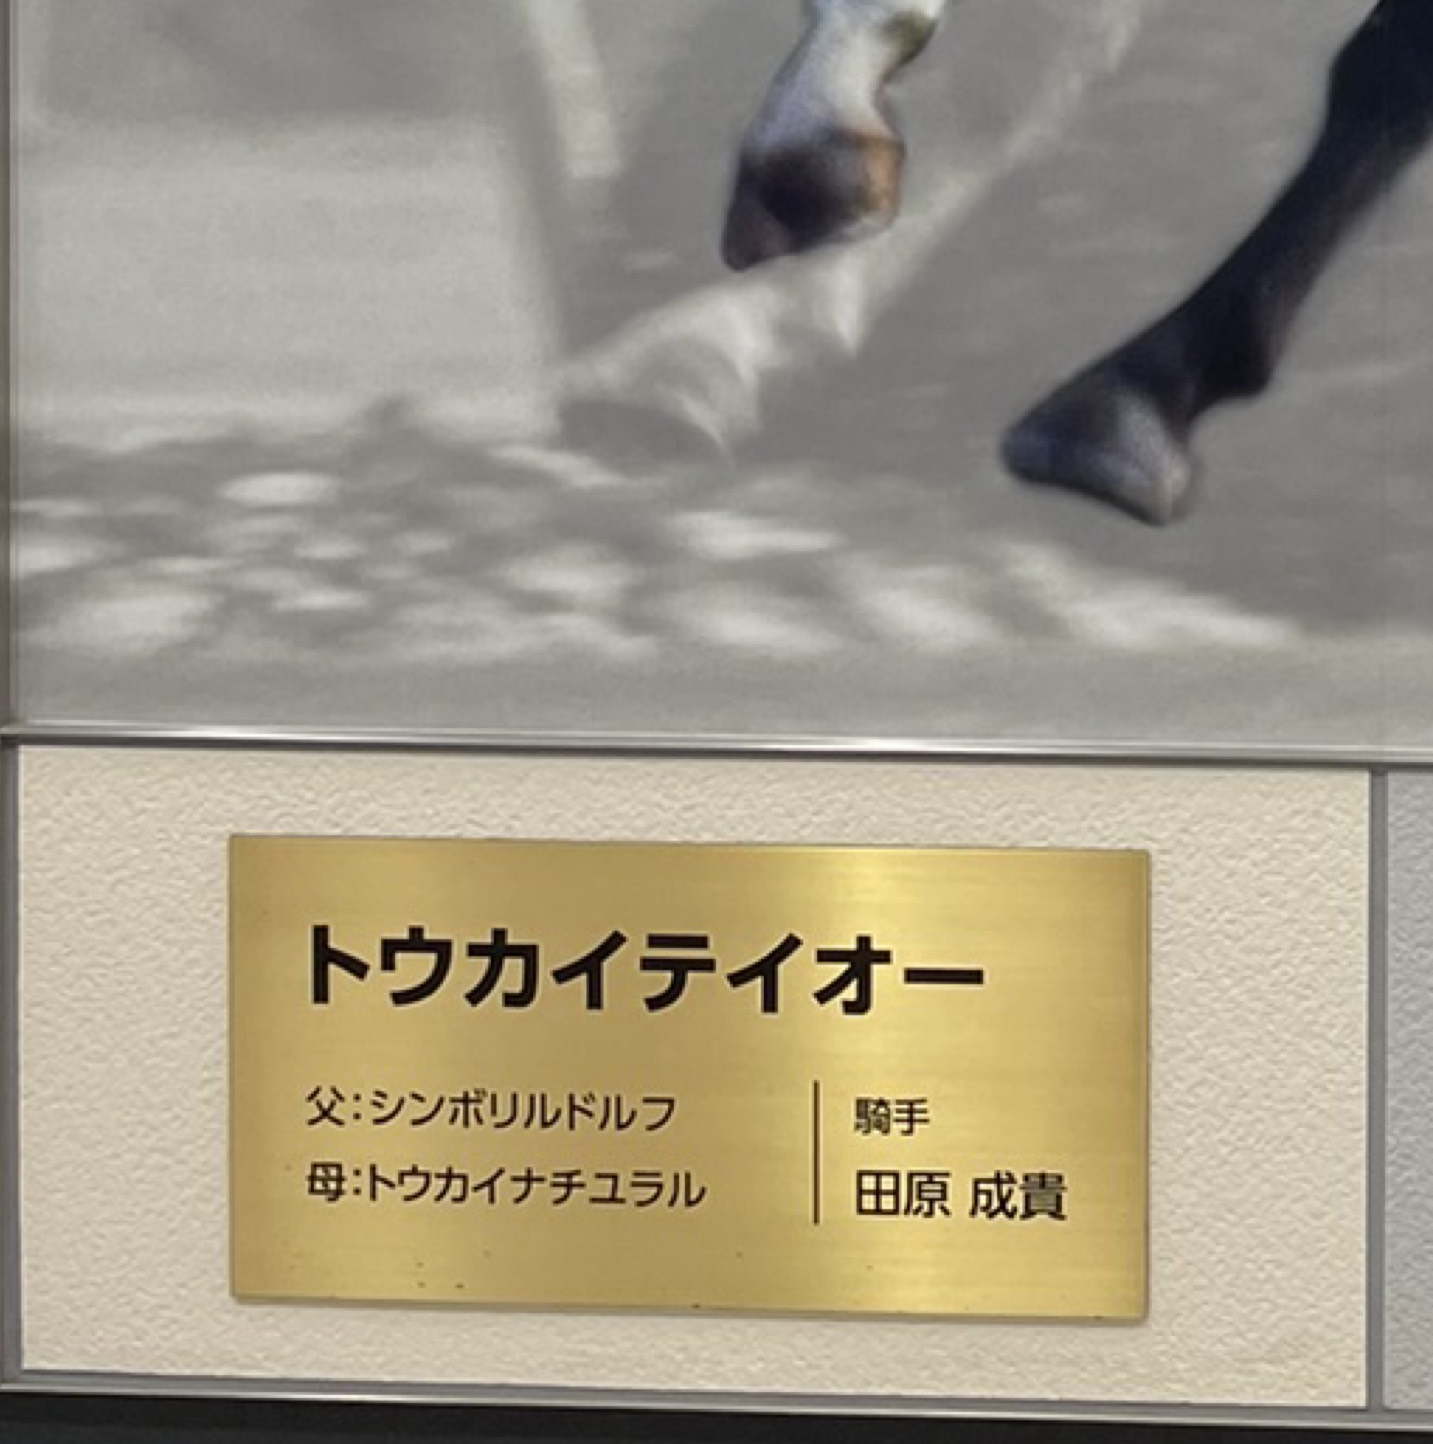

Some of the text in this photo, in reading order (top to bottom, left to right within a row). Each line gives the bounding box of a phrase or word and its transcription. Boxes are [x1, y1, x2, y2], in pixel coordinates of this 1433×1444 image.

[310, 924, 985, 1016] トウカイテイオー
[853, 1097, 930, 1136] 騎手
[855, 1170, 1068, 1221] 田原 成貴
